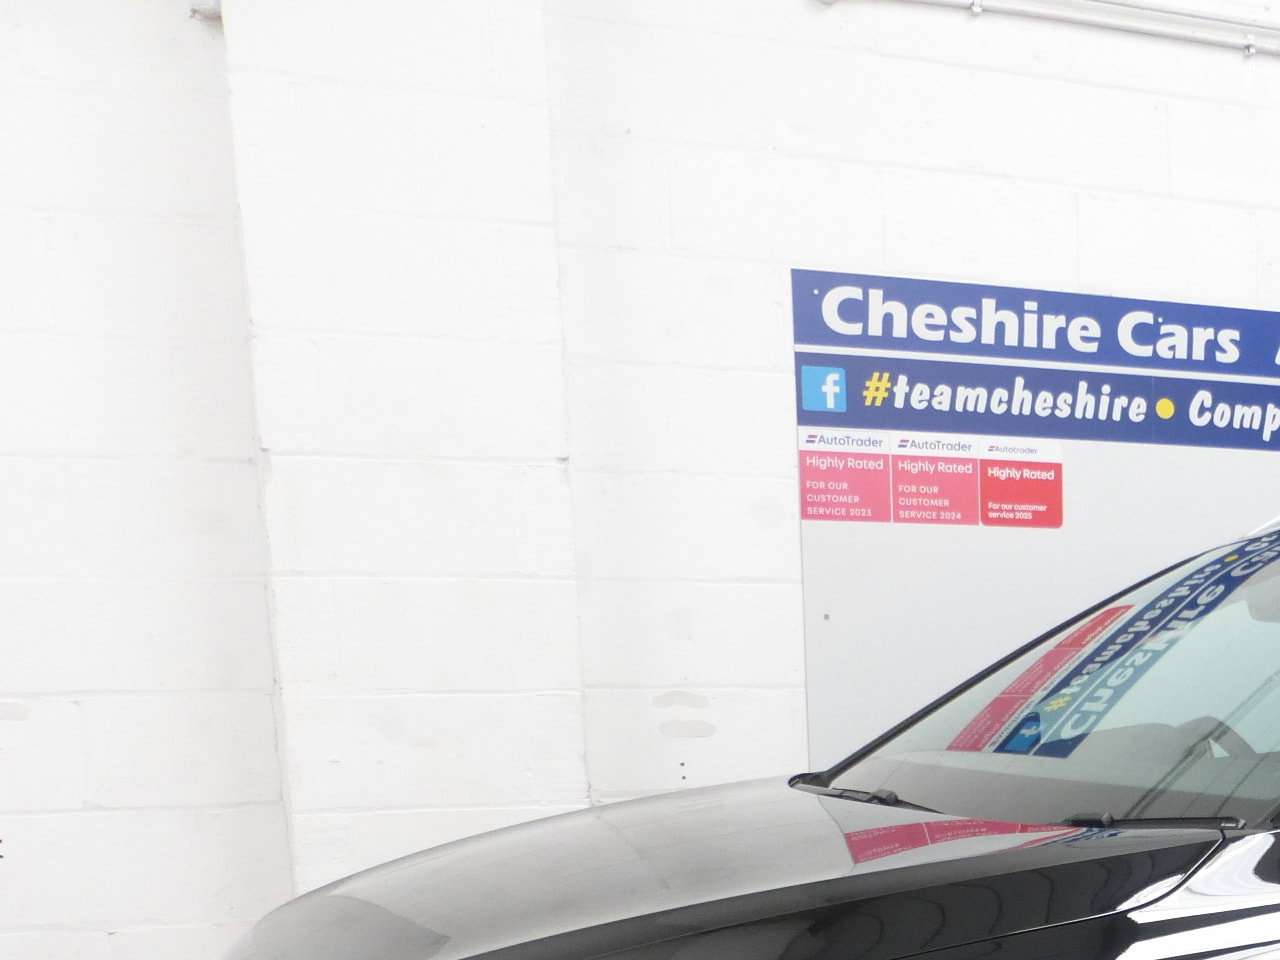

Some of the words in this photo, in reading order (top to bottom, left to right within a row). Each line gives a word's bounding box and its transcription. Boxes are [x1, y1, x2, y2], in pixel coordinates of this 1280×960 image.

[821, 286, 1101, 352] Cheshire
[1117, 311, 1241, 363] Cars
[862, 372, 1147, 423] #teamcheshire
[817, 435, 884, 447] AutoTrader
[909, 439, 973, 451] AutoTrader
[806, 455, 845, 470] Highly
[847, 457, 884, 470] Rated
[898, 460, 935, 474] Highly
[938, 462, 973, 474] Rated
[987, 467, 1021, 480] Highly
[1023, 469, 1055, 480] Rated
[806, 481, 825, 489] FOR
[827, 482, 849, 490] OUR
[898, 485, 917, 493] FOR
[920, 486, 939, 494] OUR
[806, 494, 860, 503] CUSTOMER
[899, 498, 950, 507] CUSTOMER
[807, 507, 846, 516] SERVICE
[988, 502, 1000, 510] For
[1013, 503, 1047, 511] customer
[899, 510, 937, 519] SERVICE
